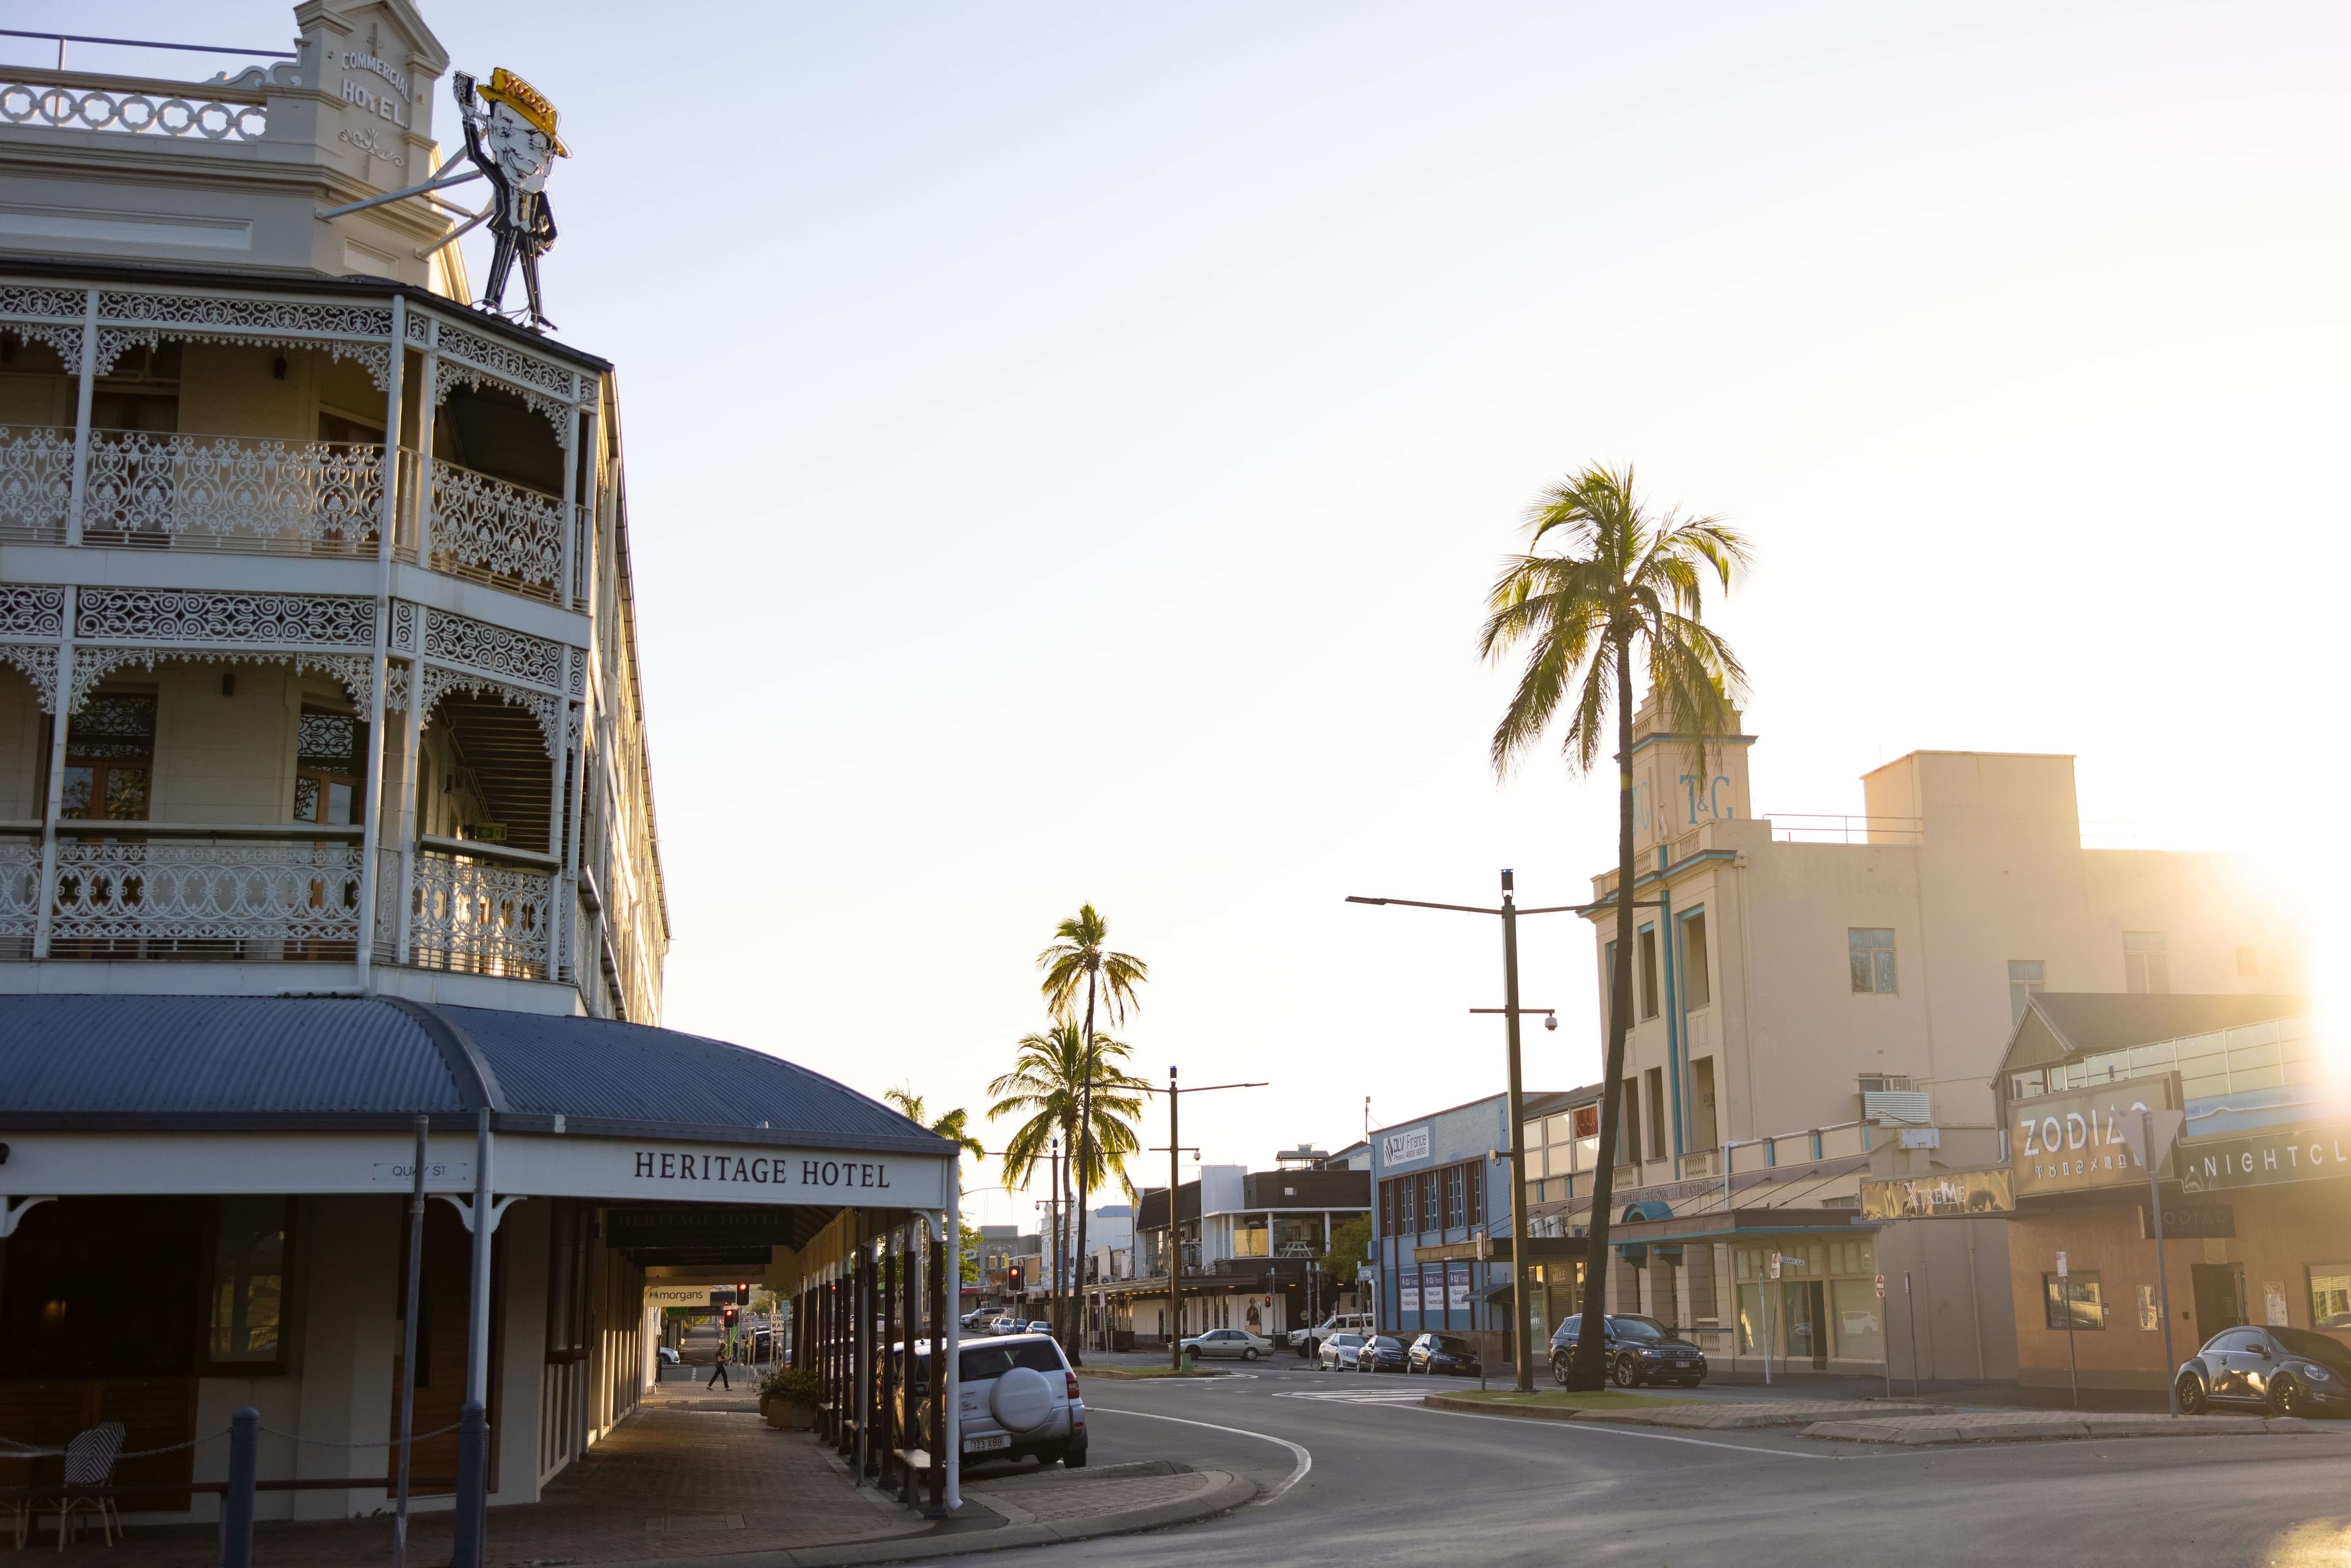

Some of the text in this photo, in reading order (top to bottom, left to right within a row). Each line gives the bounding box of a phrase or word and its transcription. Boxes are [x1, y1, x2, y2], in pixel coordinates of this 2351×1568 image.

[343, 52, 410, 103] COMMERCIAL
[1393, 1134, 1426, 1153] DLV Finance
[2020, 1103, 2148, 1157] ZODIA
[634, 1152, 890, 1188] HERITAGE HOTEL
[1616, 1193, 1637, 1206] MUTUAL
[1655, 1185, 1681, 1201] SOCIETY
[659, 1290, 703, 1301] morgans
